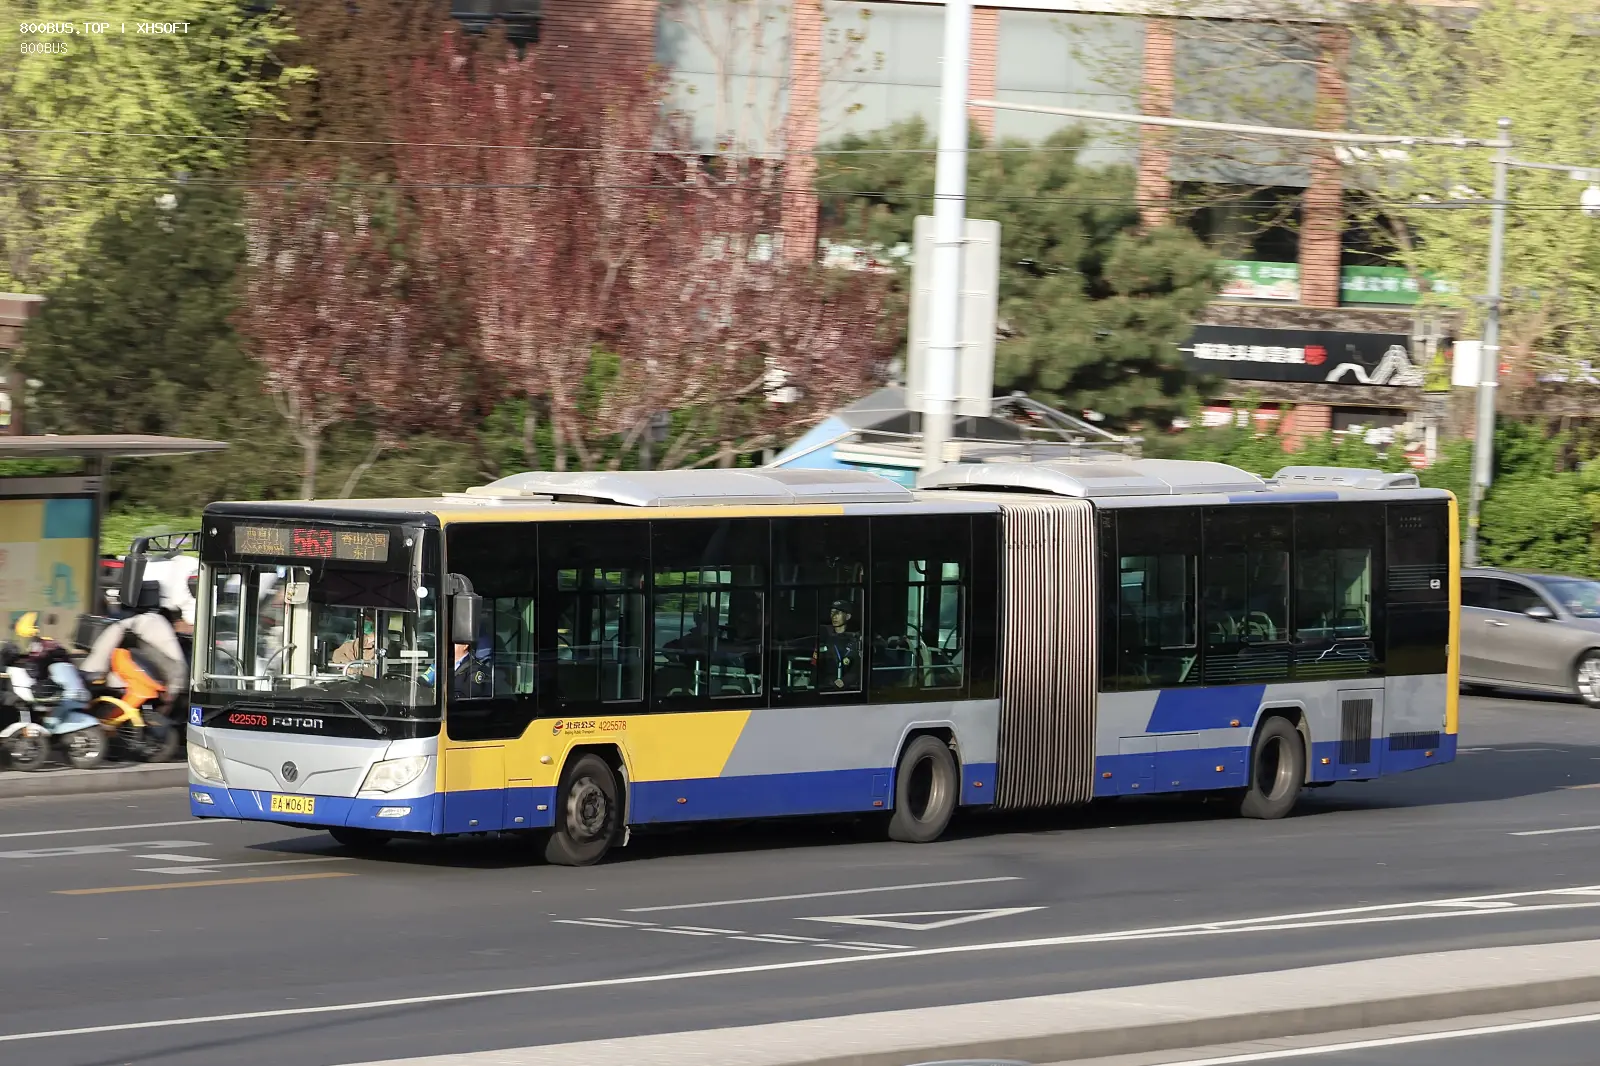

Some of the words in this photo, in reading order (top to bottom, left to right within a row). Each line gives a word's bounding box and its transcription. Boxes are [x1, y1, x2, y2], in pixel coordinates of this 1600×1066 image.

[294, 528, 333, 558] 563
[341, 532, 386, 548] 香山公园
[353, 546, 375, 560] 东门
[228, 713, 268, 726] 4225578
[272, 717, 324, 729] FOTON
[565, 720, 596, 730] 北京公交
[598, 720, 627, 731] 4225578
